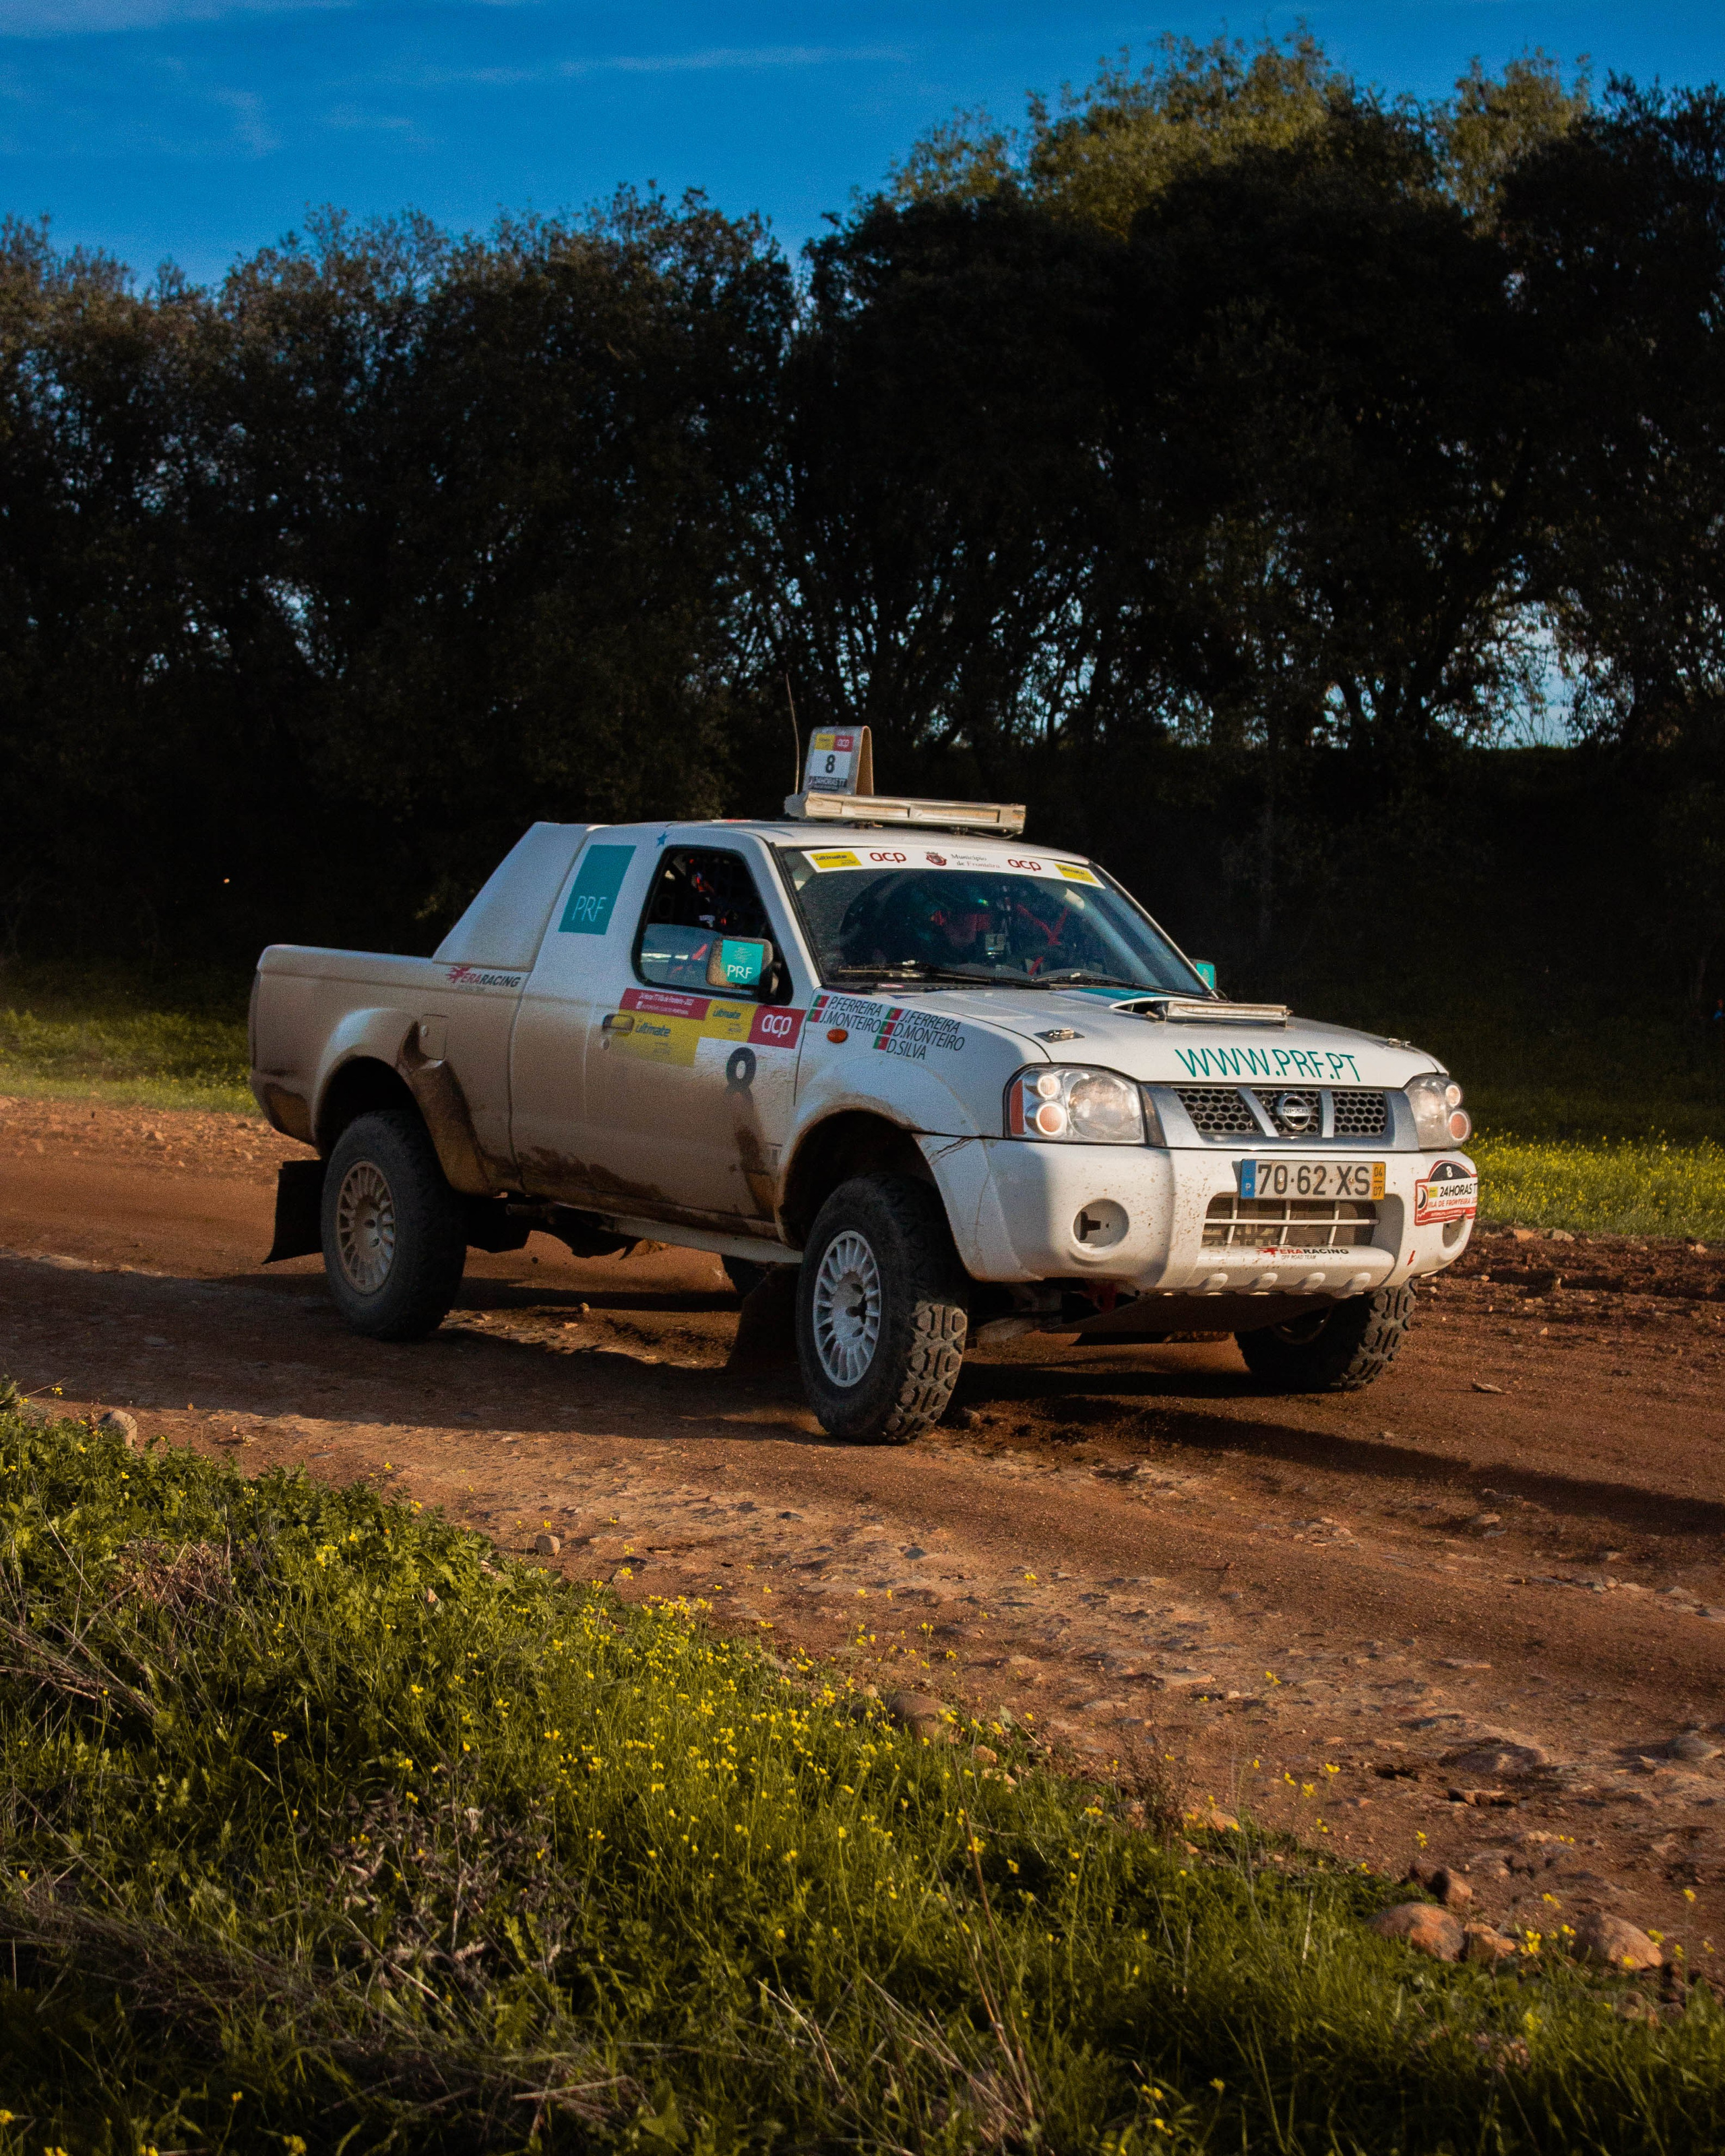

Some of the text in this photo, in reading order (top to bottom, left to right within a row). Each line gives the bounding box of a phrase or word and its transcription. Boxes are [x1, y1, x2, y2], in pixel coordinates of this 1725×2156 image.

[825, 754, 836, 773] 8
[869, 852, 907, 863] acp
[1007, 858, 1042, 872] acp
[571, 895, 607, 922] PRF
[727, 964, 753, 979] PRF
[761, 1013, 792, 1038] acp
[886, 1038, 927, 1060] D.SILVA
[1174, 1048, 1361, 1082] WWW.PRF.PT
[1374, 1166, 1383, 1177] 04
[1446, 1166, 1453, 1178] 8
[1373, 1186, 1382, 1197] 07
